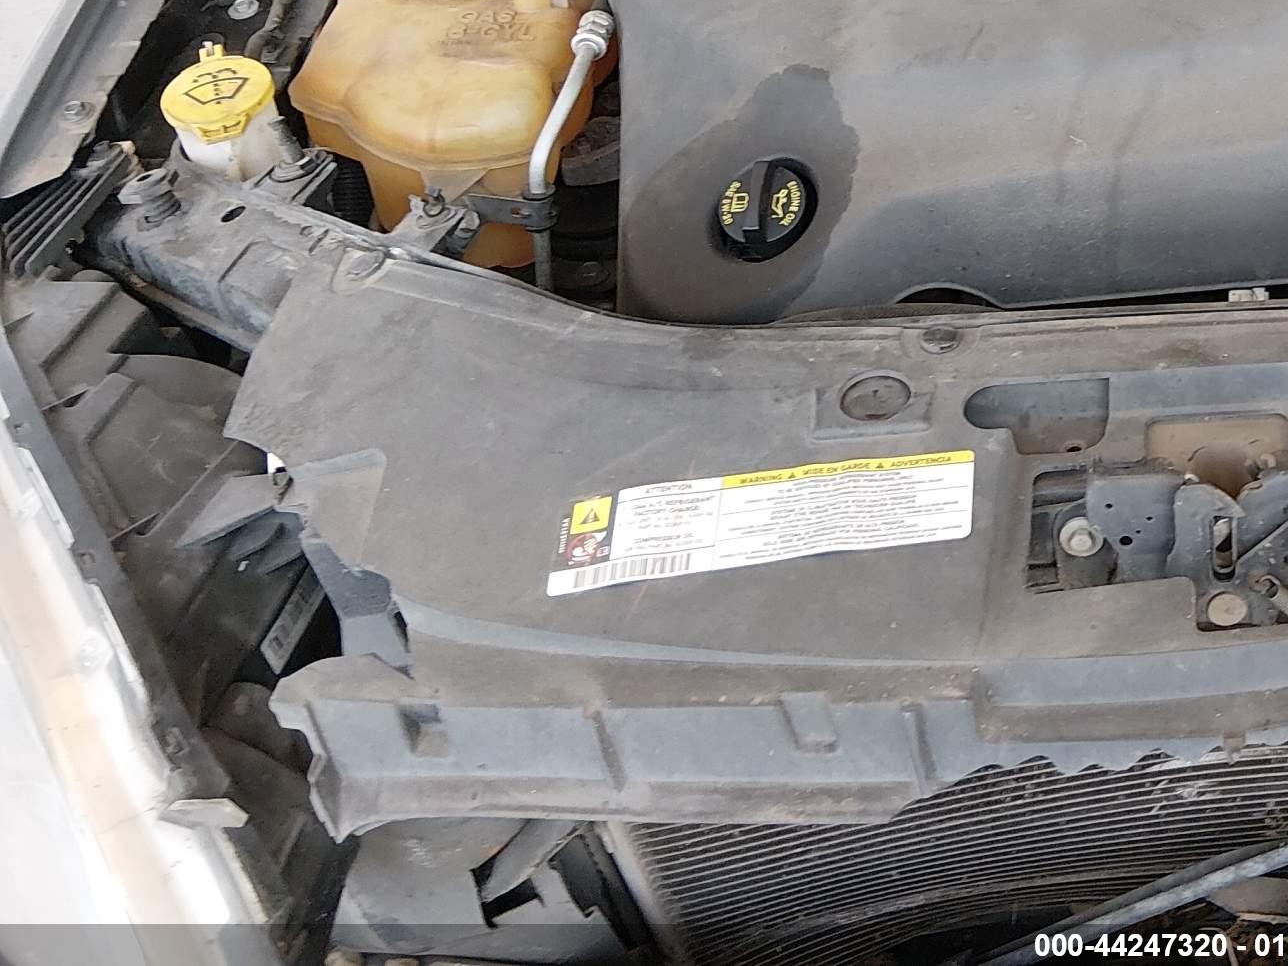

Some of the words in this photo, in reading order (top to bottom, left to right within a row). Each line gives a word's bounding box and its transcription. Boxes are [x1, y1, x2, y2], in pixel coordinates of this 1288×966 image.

[786, 180, 801, 212] ENGINE
[778, 212, 796, 226] OIL
[739, 473, 783, 485] WARNING
